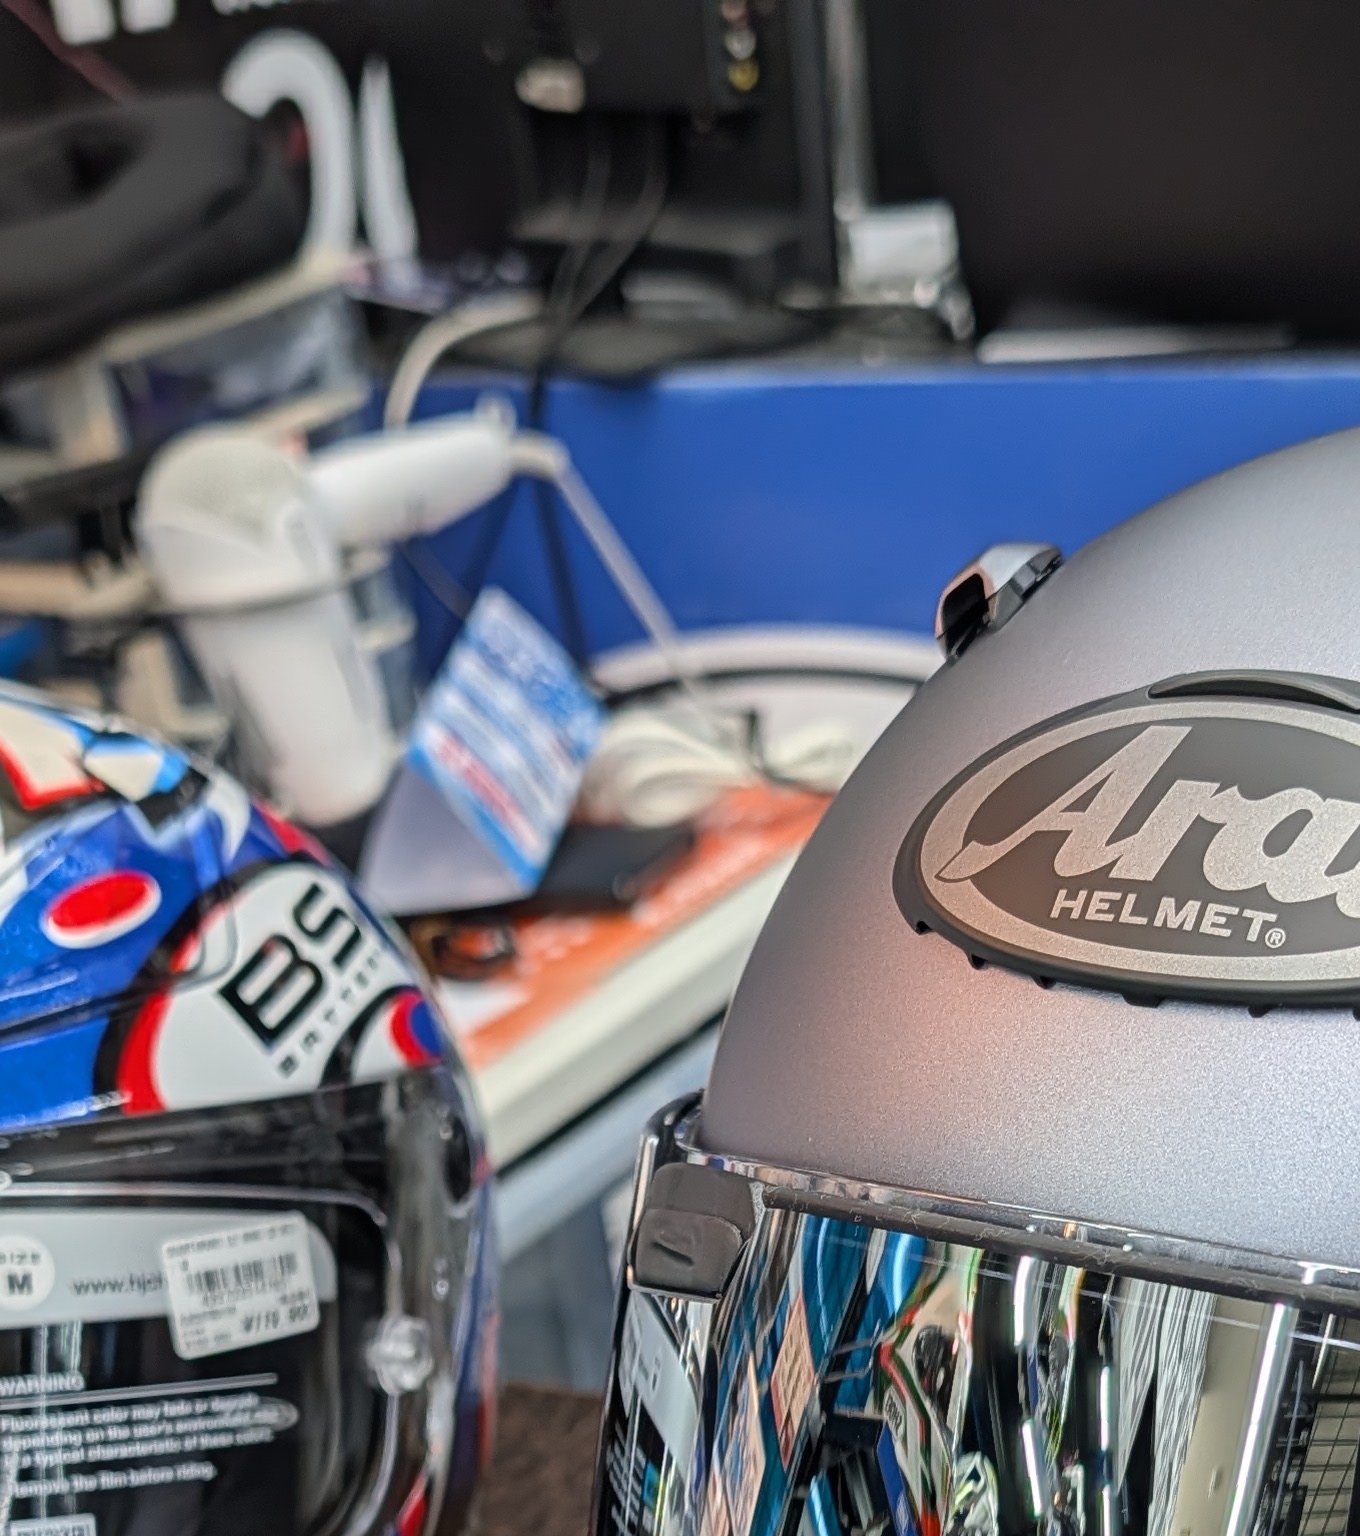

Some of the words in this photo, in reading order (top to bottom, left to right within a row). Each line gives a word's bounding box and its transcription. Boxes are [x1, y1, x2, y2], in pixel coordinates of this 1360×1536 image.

[219, 882, 362, 1049] BS
[7, 1272, 34, 1297] M
[93, 1404, 129, 1424] color
[131, 1403, 161, 1422] may
[107, 1424, 130, 1441] the
[16, 1478, 70, 1498] emove
